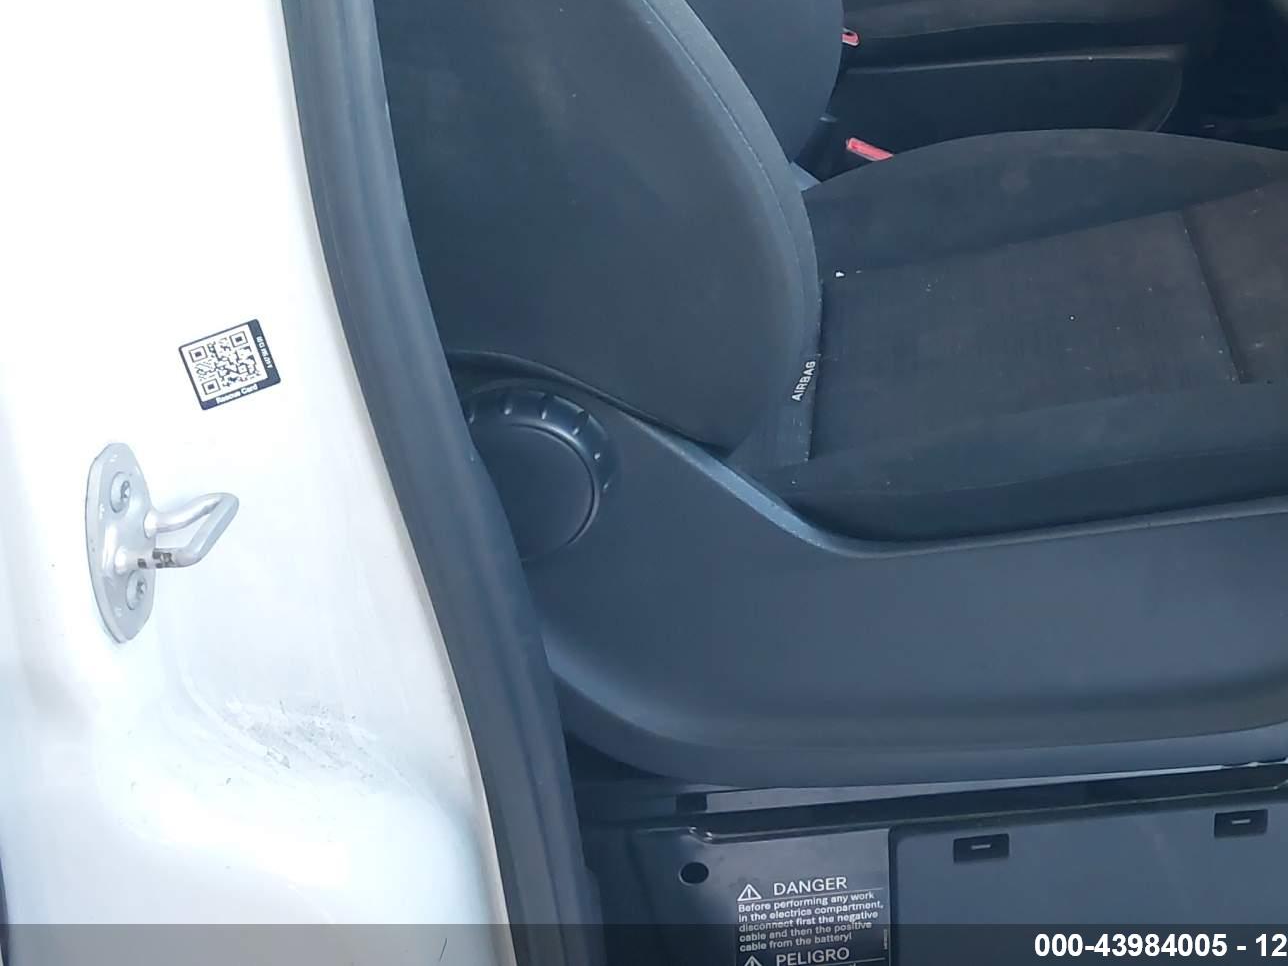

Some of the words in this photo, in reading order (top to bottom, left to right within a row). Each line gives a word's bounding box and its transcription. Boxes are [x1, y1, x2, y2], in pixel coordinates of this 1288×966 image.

[792, 361, 816, 401] AIRBAG
[773, 876, 848, 896] DANGER
[738, 904, 772, 913] Before
[774, 897, 828, 910] performing
[831, 895, 848, 903] any
[850, 891, 874, 902] work
[750, 912, 768, 921] the
[770, 908, 812, 920] electrics
[814, 900, 884, 914] compartment,
[738, 920, 794, 932] disconnect
[796, 916, 816, 926] first
[818, 913, 834, 924] the
[837, 910, 878, 923] negative
[739, 932, 767, 942] cable
[769, 929, 788, 939] and
[790, 927, 812, 937] then
[816, 924, 832, 934] the
[834, 921, 872, 933] positive
[740, 942, 767, 952] cable
[769, 939, 793, 949] from
[796, 936, 812, 946] the
[776, 947, 850, 966] PELIGRO
